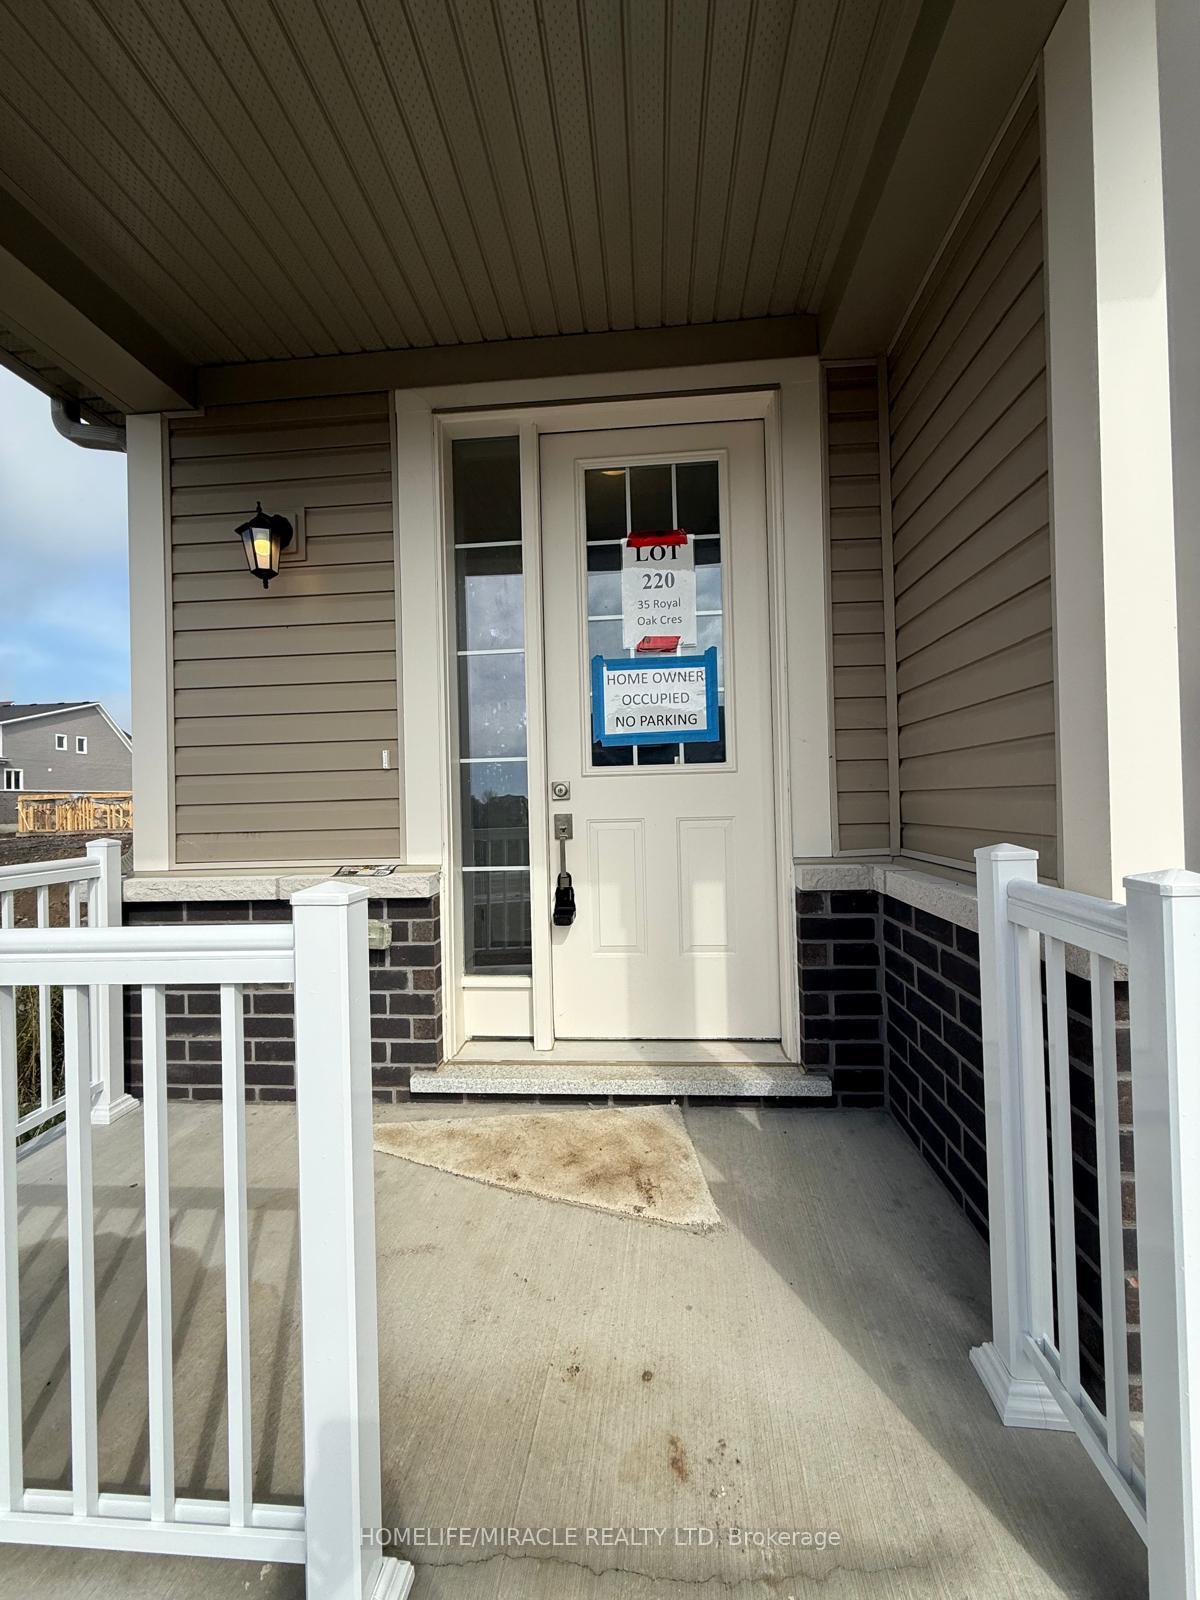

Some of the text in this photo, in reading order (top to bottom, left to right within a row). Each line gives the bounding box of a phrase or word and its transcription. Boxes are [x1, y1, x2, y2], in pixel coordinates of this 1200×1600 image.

[635, 545, 681, 562] LOT
[642, 572, 675, 589] 220
[637, 597, 681, 609] 35 Royal
[637, 615, 682, 625] Oak Cres
[607, 670, 704, 686] HOME OWNER
[622, 692, 690, 706] OCCUPIED
[615, 713, 698, 728] NO PARKING
